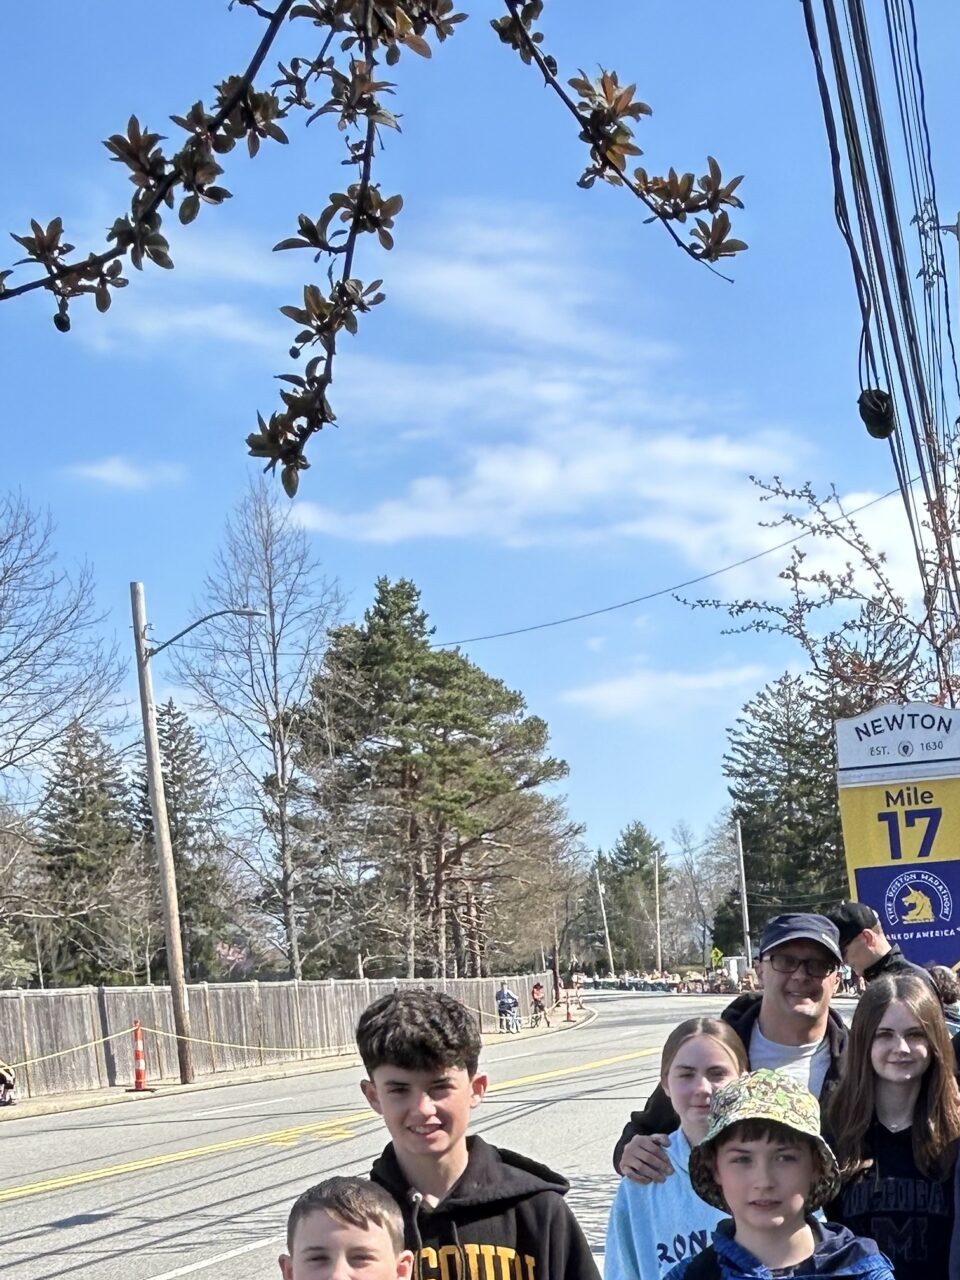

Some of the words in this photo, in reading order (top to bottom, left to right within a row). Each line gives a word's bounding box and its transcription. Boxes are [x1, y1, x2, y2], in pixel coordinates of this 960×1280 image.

[854, 713, 953, 742] NEWTON
[870, 745, 890, 757] EST.
[920, 740, 944, 752] 1630
[885, 786, 934, 808] Mile
[877, 807, 943, 860] 17
[888, 873, 917, 898] BOSTON
[920, 873, 951, 915] MARATHON
[903, 932, 914, 940] OF
[915, 928, 956, 939] AMERICA
